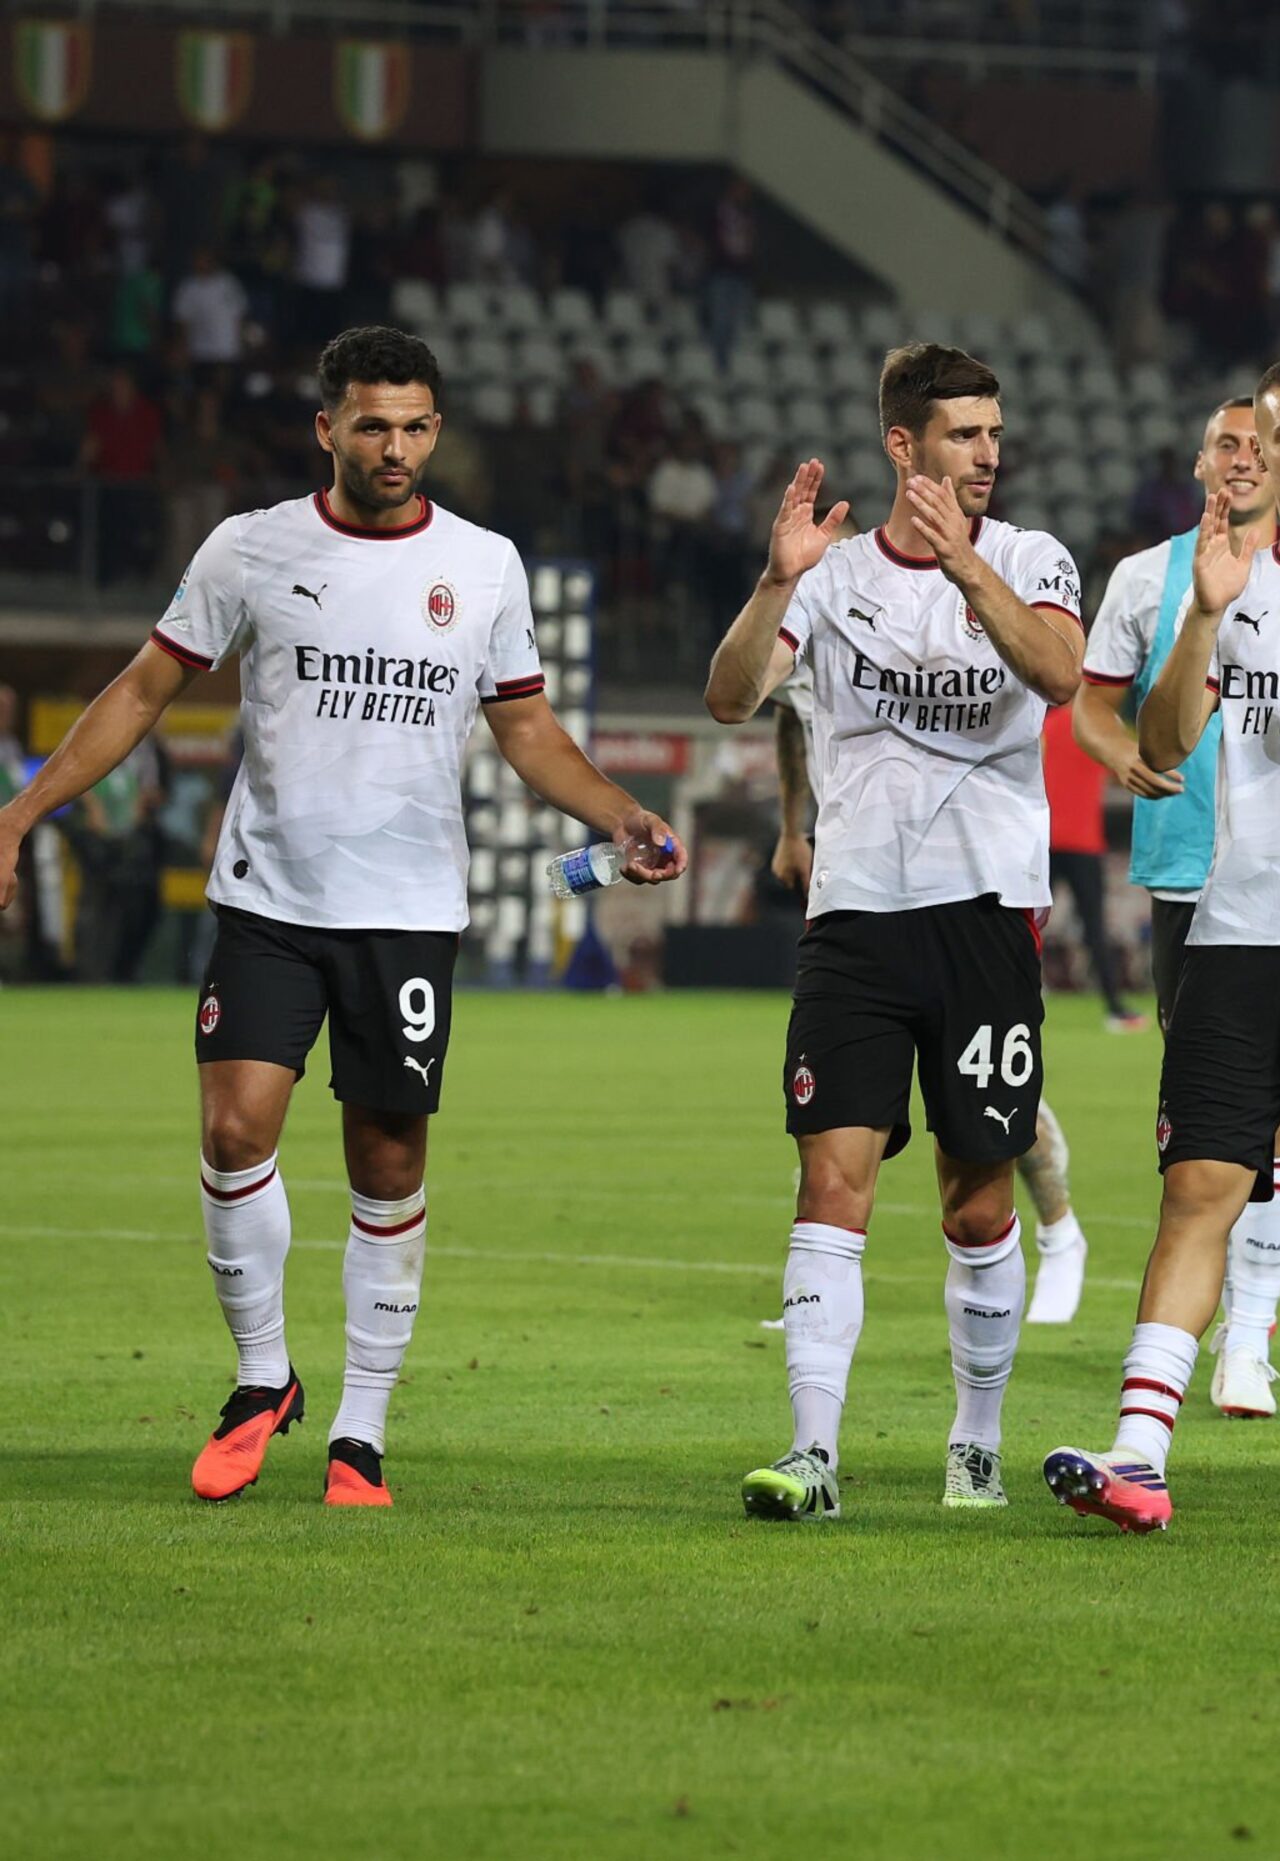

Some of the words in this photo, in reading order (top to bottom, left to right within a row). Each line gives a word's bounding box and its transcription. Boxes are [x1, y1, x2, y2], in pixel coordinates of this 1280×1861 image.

[295, 645, 459, 695] Emirates
[316, 689, 356, 718] FLY
[875, 699, 910, 724] FLY
[915, 701, 992, 732] BETTER
[1241, 706, 1274, 734] FLY
[398, 977, 435, 1042] 9
[957, 1023, 1033, 1088] 46
